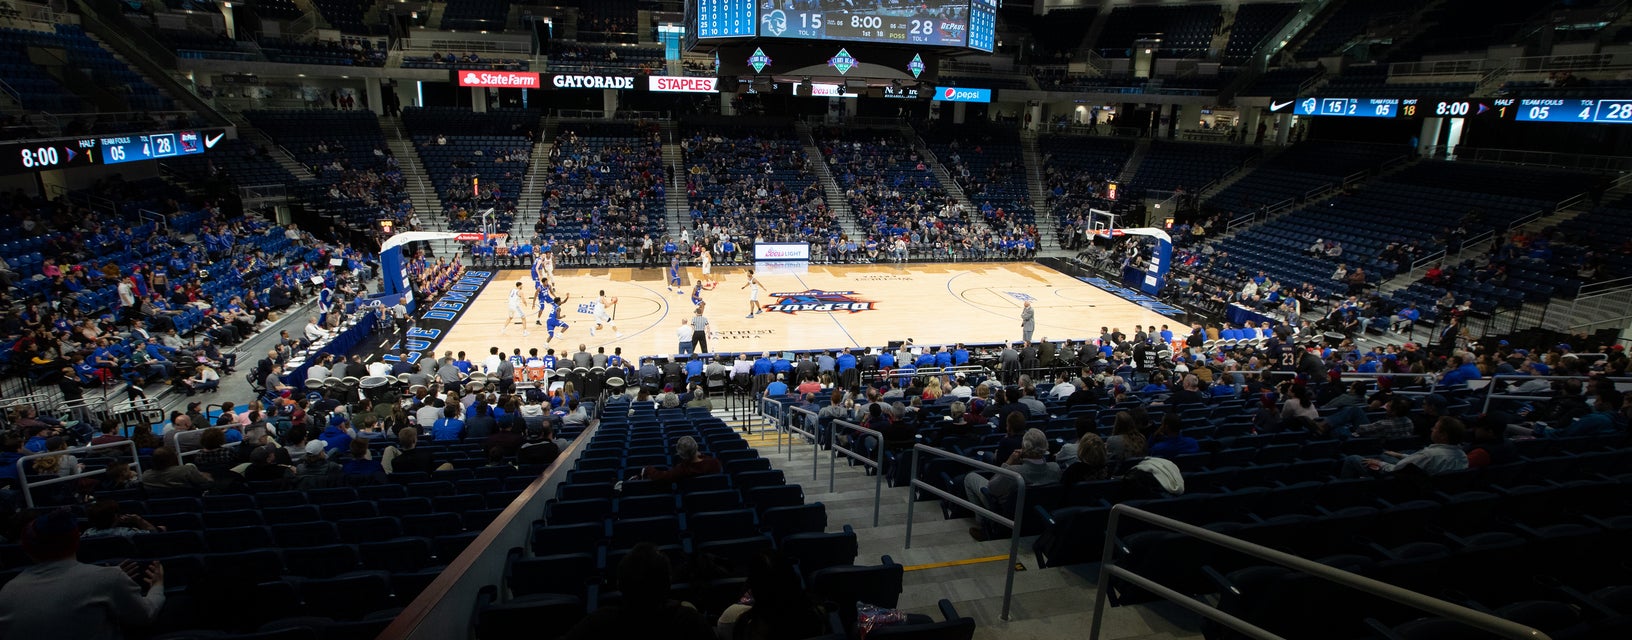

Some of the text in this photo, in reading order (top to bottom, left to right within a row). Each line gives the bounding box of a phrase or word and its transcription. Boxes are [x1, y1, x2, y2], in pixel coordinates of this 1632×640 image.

[800, 13, 822, 29] 15
[851, 15, 882, 29] 8:00
[910, 20, 933, 35] 28
[553, 75, 634, 89] GATORADE
[657, 78, 711, 90] STAPLES
[956, 91, 979, 99] pepsi
[1329, 102, 1341, 112] 15
[1349, 105, 1355, 114] 2
[1375, 105, 1389, 115] 05
[1403, 106, 1415, 115] 18
[1436, 102, 1469, 115] 8:00
[1499, 107, 1506, 118] 1
[1529, 107, 1549, 119] 05
[1579, 107, 1590, 119] 4
[1606, 104, 1632, 118] 28
[79, 139, 95, 148] HALF
[157, 138, 171, 153] 28
[86, 149, 93, 163] 1
[111, 146, 125, 160] 05
[143, 144, 150, 157] 4
[21, 147, 58, 168] 8:00
[765, 248, 784, 257] Coors
[383, 270, 491, 365] LUE DEMONS
[1282, 353, 1294, 365] 23
